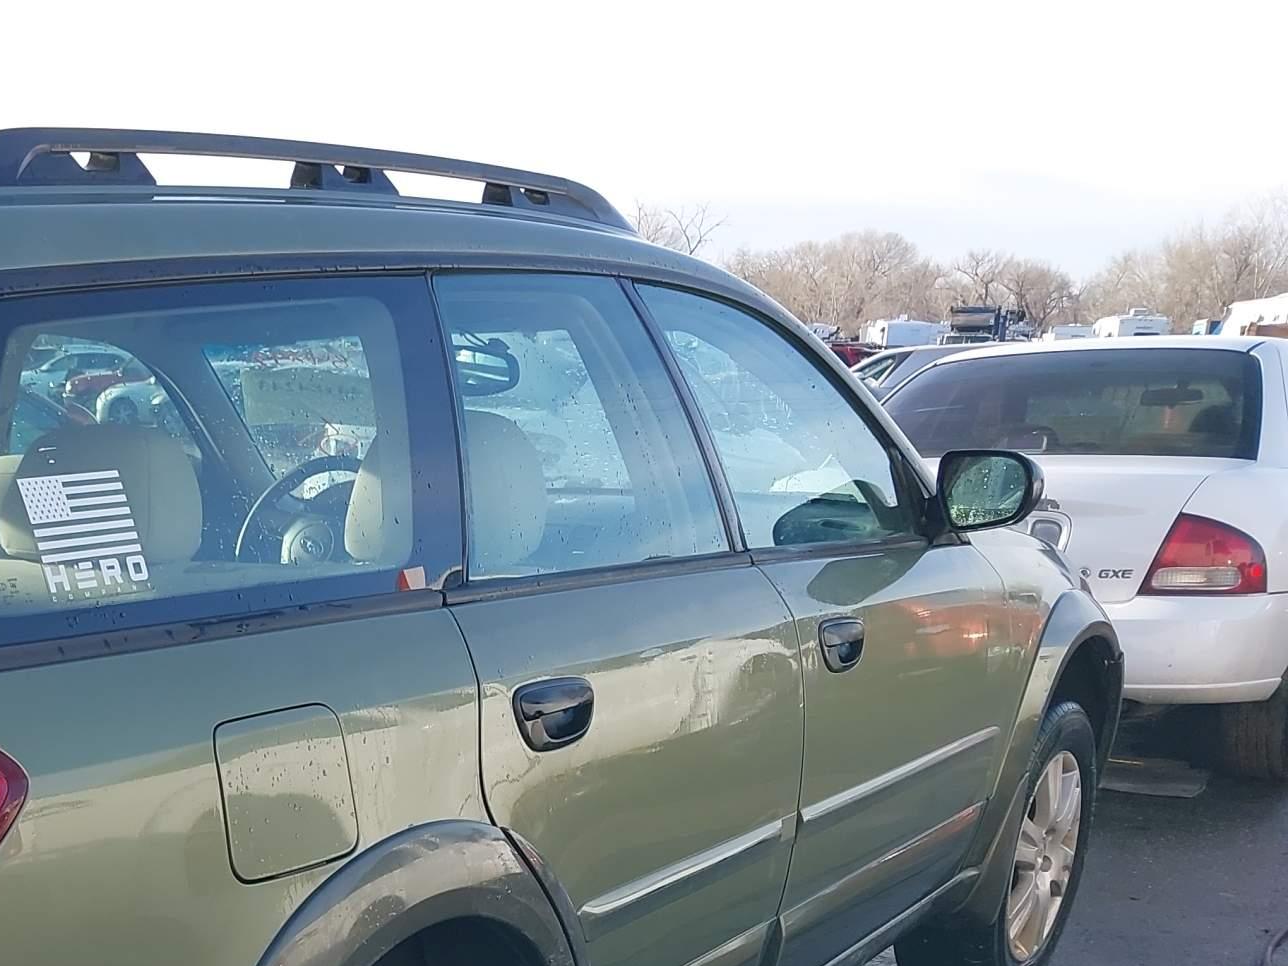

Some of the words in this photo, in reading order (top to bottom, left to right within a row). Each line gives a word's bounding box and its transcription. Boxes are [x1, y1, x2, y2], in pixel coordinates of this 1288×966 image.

[44, 555, 149, 593] HERO
[1098, 569, 1134, 579] GXE
[52, 583, 152, 602] COMPANY
